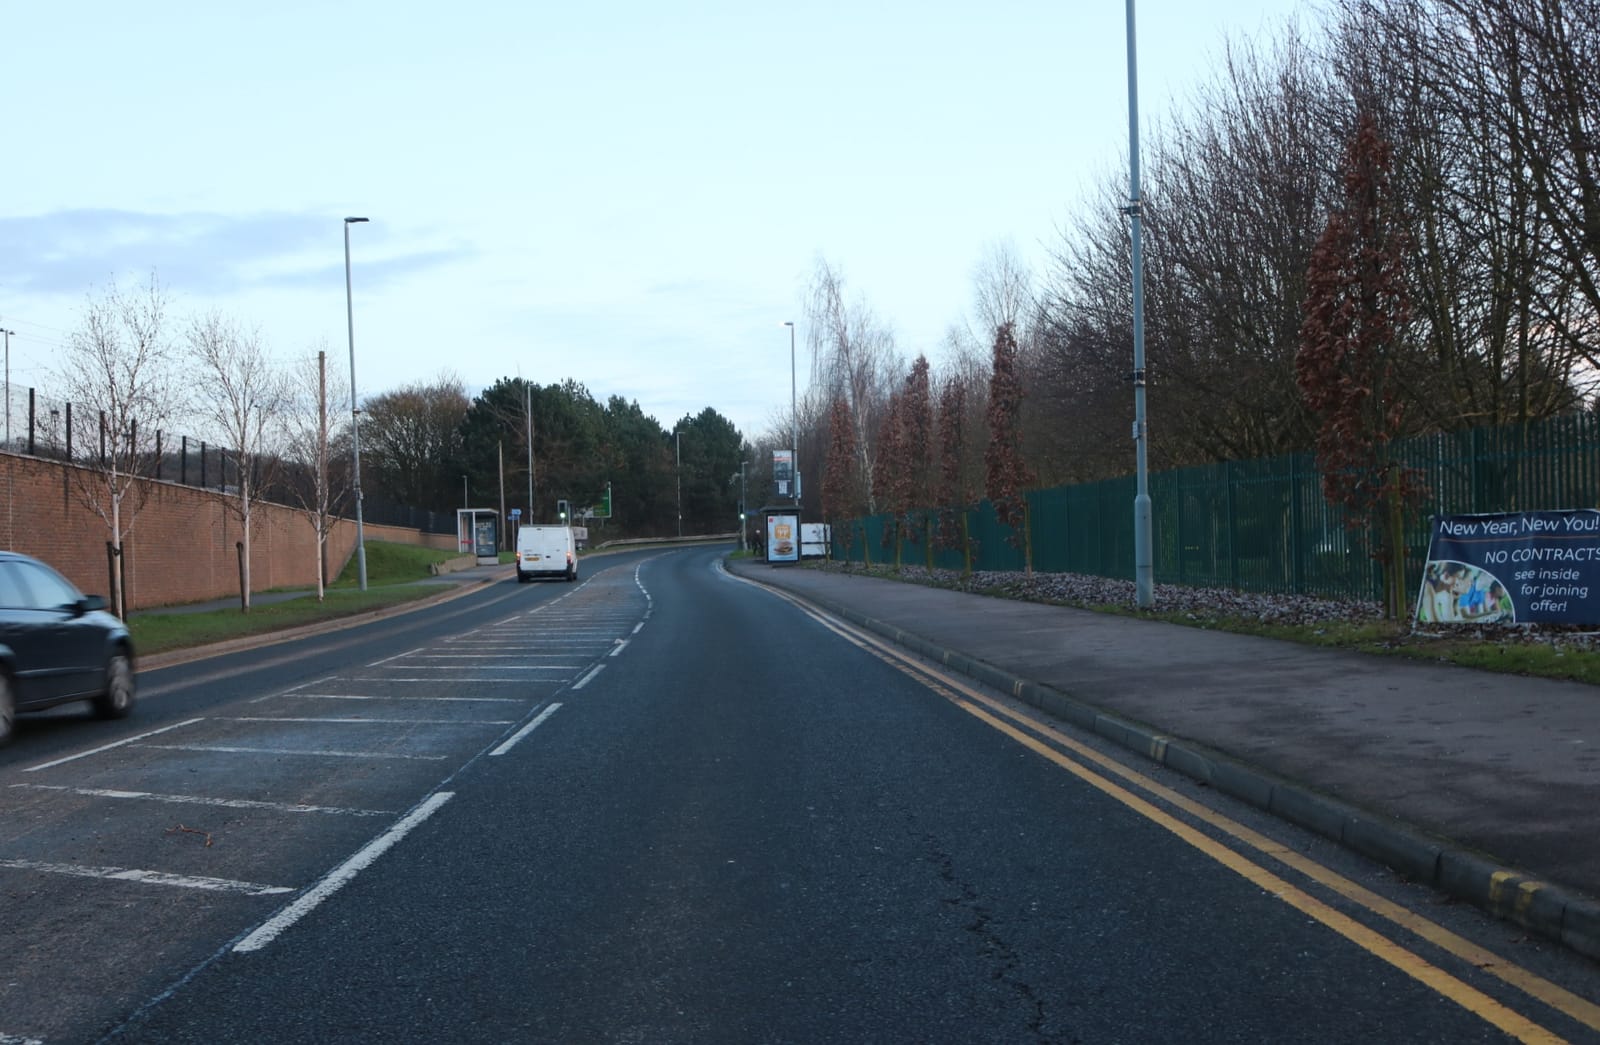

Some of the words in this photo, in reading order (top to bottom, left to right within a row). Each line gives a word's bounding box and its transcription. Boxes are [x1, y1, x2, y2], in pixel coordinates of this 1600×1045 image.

[1440, 521, 1478, 535] New
[1481, 519, 1518, 535] Year,
[1522, 516, 1559, 532] New
[1563, 516, 1600, 531] You!
[1485, 551, 1508, 564] NO
[1514, 571, 1536, 580] see
[1539, 568, 1580, 580] inside
[1521, 584, 1539, 595] for
[1540, 584, 1588, 598] joining
[1530, 600, 1568, 612] offer!
